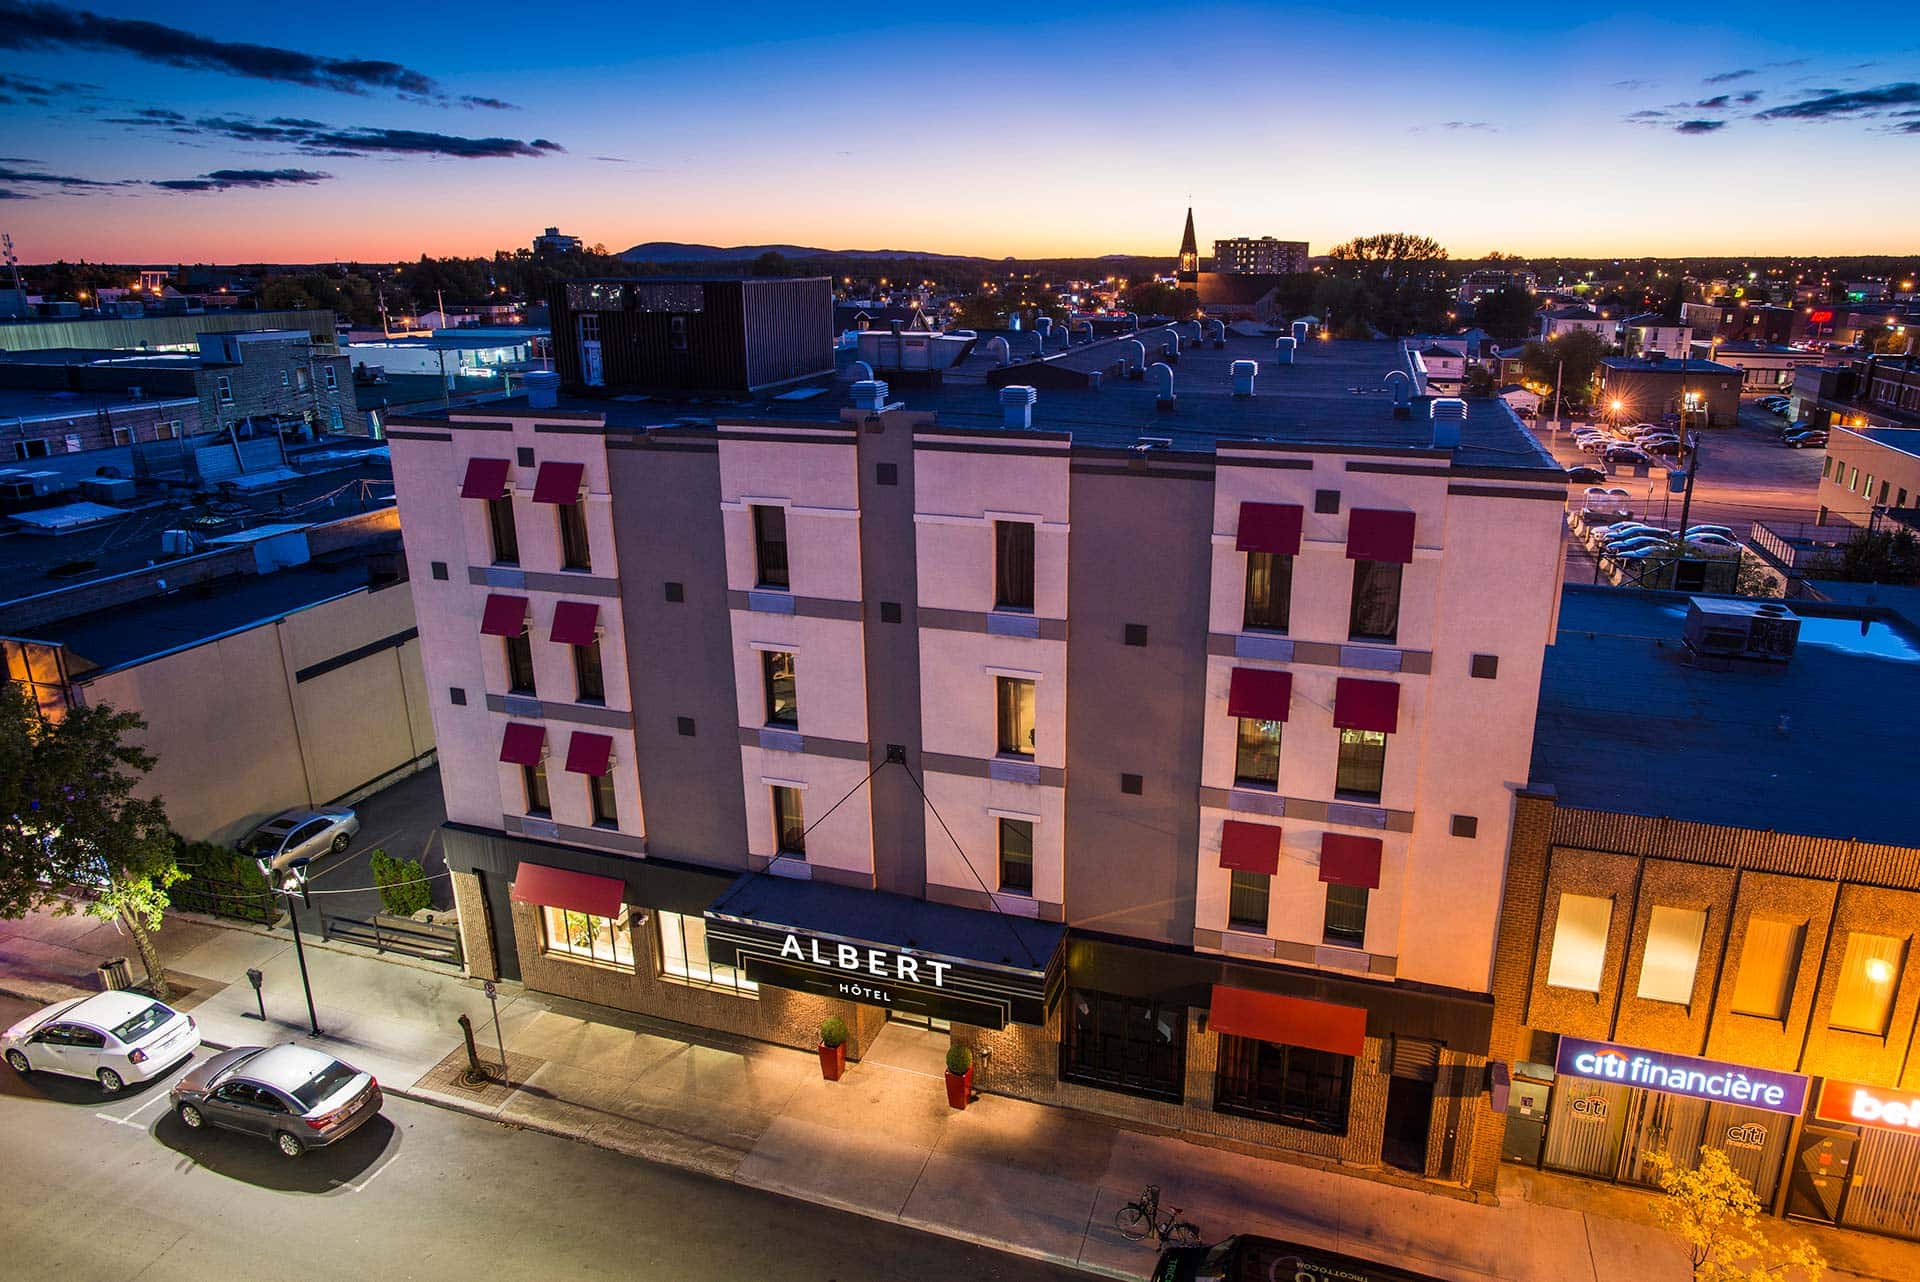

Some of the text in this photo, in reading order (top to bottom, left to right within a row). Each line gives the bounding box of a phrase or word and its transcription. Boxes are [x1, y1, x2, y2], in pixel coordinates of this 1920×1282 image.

[780, 934, 951, 987] ALBERT
[839, 983, 891, 1002] HÔTEL
[1631, 1057, 1785, 1105] financière
[1572, 1099, 1607, 1117] citi
[1727, 1126, 1766, 1145] citi
